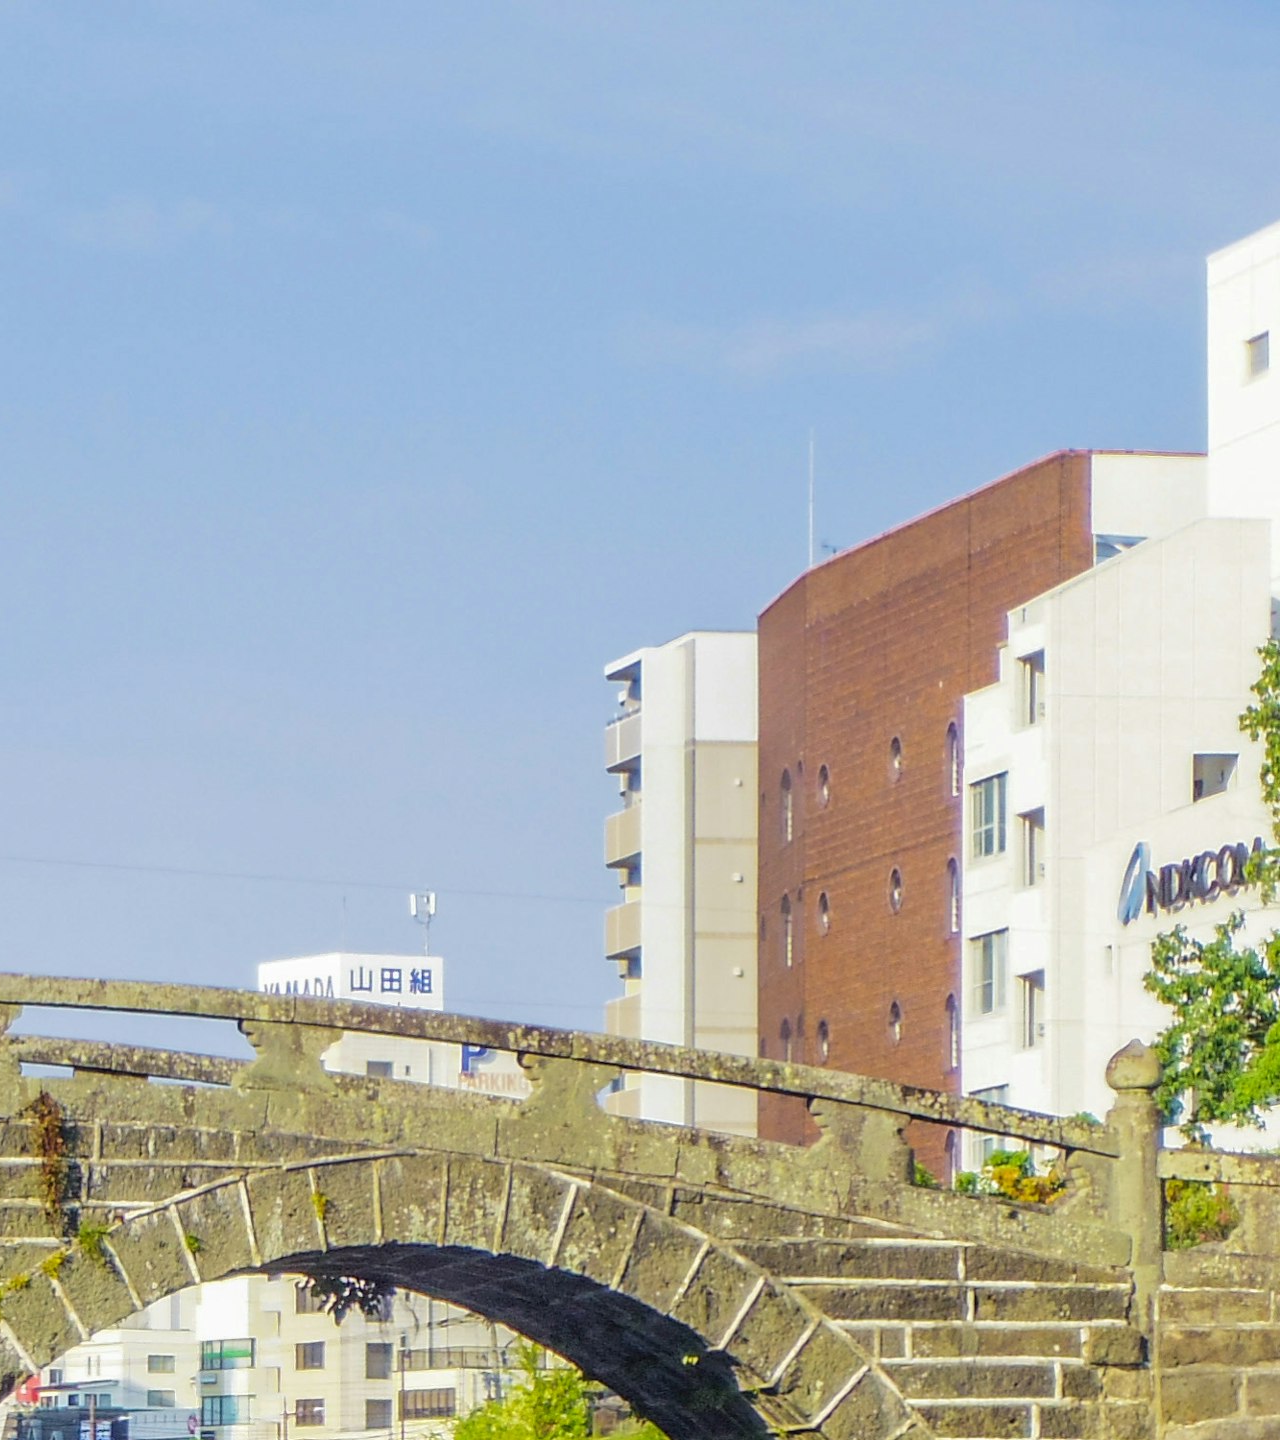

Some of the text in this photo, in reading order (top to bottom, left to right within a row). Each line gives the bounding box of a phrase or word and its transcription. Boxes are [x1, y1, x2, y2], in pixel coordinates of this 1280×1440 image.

[350, 966, 432, 994] 山田組
[462, 1044, 488, 1073] P
